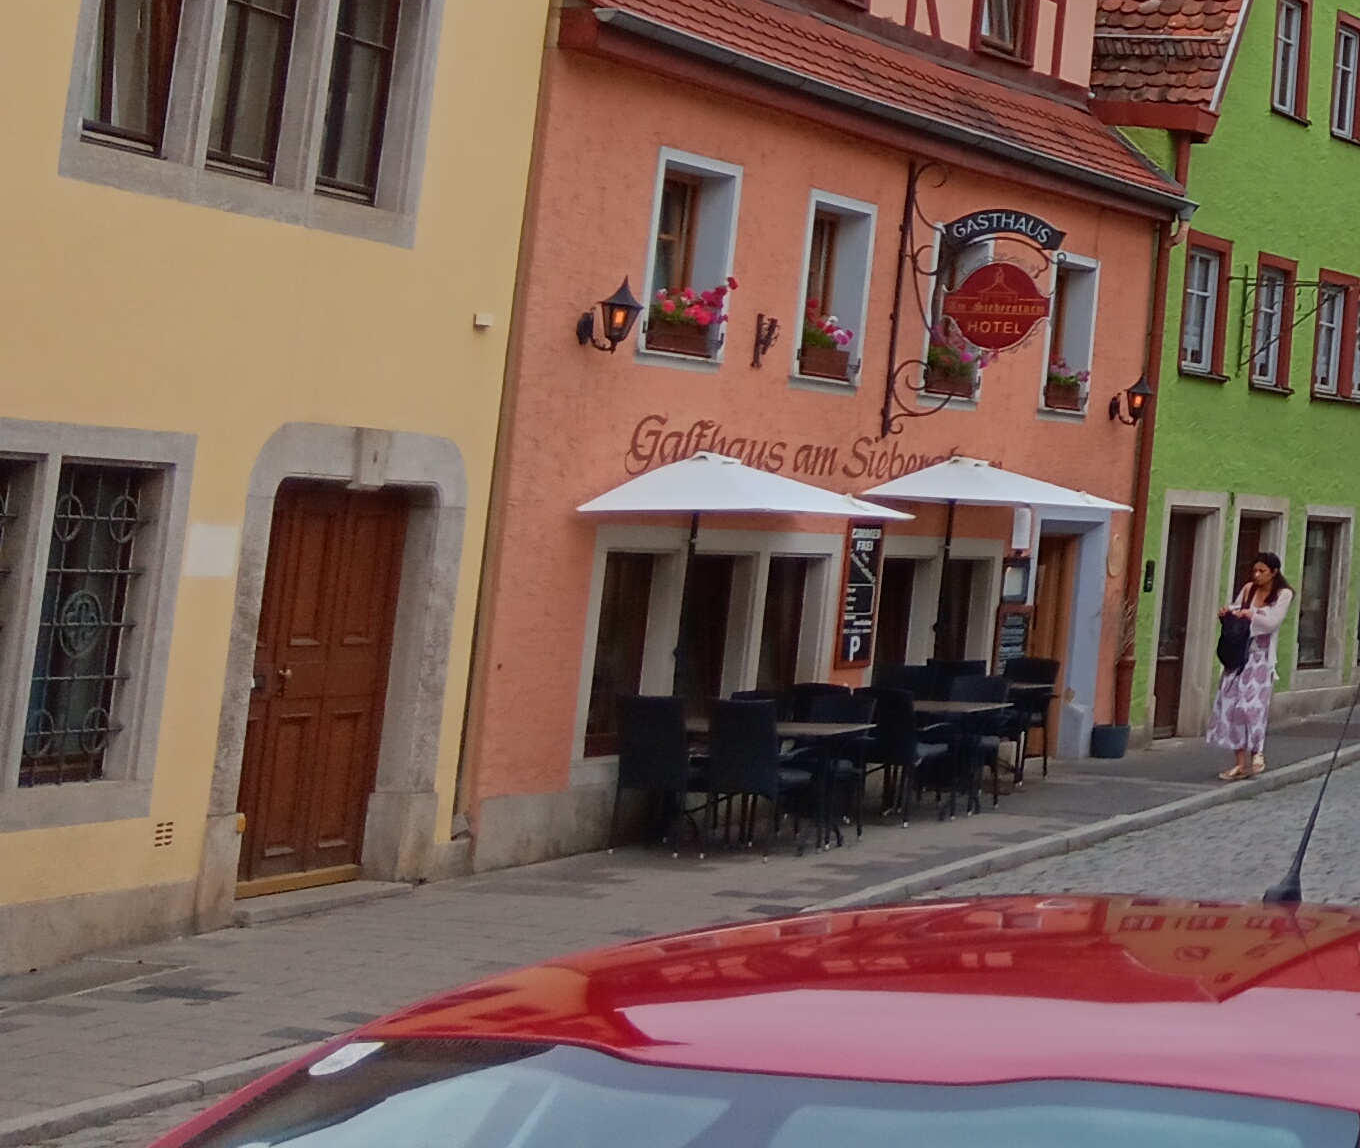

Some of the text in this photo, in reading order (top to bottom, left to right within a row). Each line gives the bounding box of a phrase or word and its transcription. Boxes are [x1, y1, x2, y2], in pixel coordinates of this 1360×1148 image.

[952, 213, 1052, 243] GASTHAUS
[967, 321, 1022, 334] HOTEL
[793, 443, 839, 476] am
[849, 635, 861, 662] P
